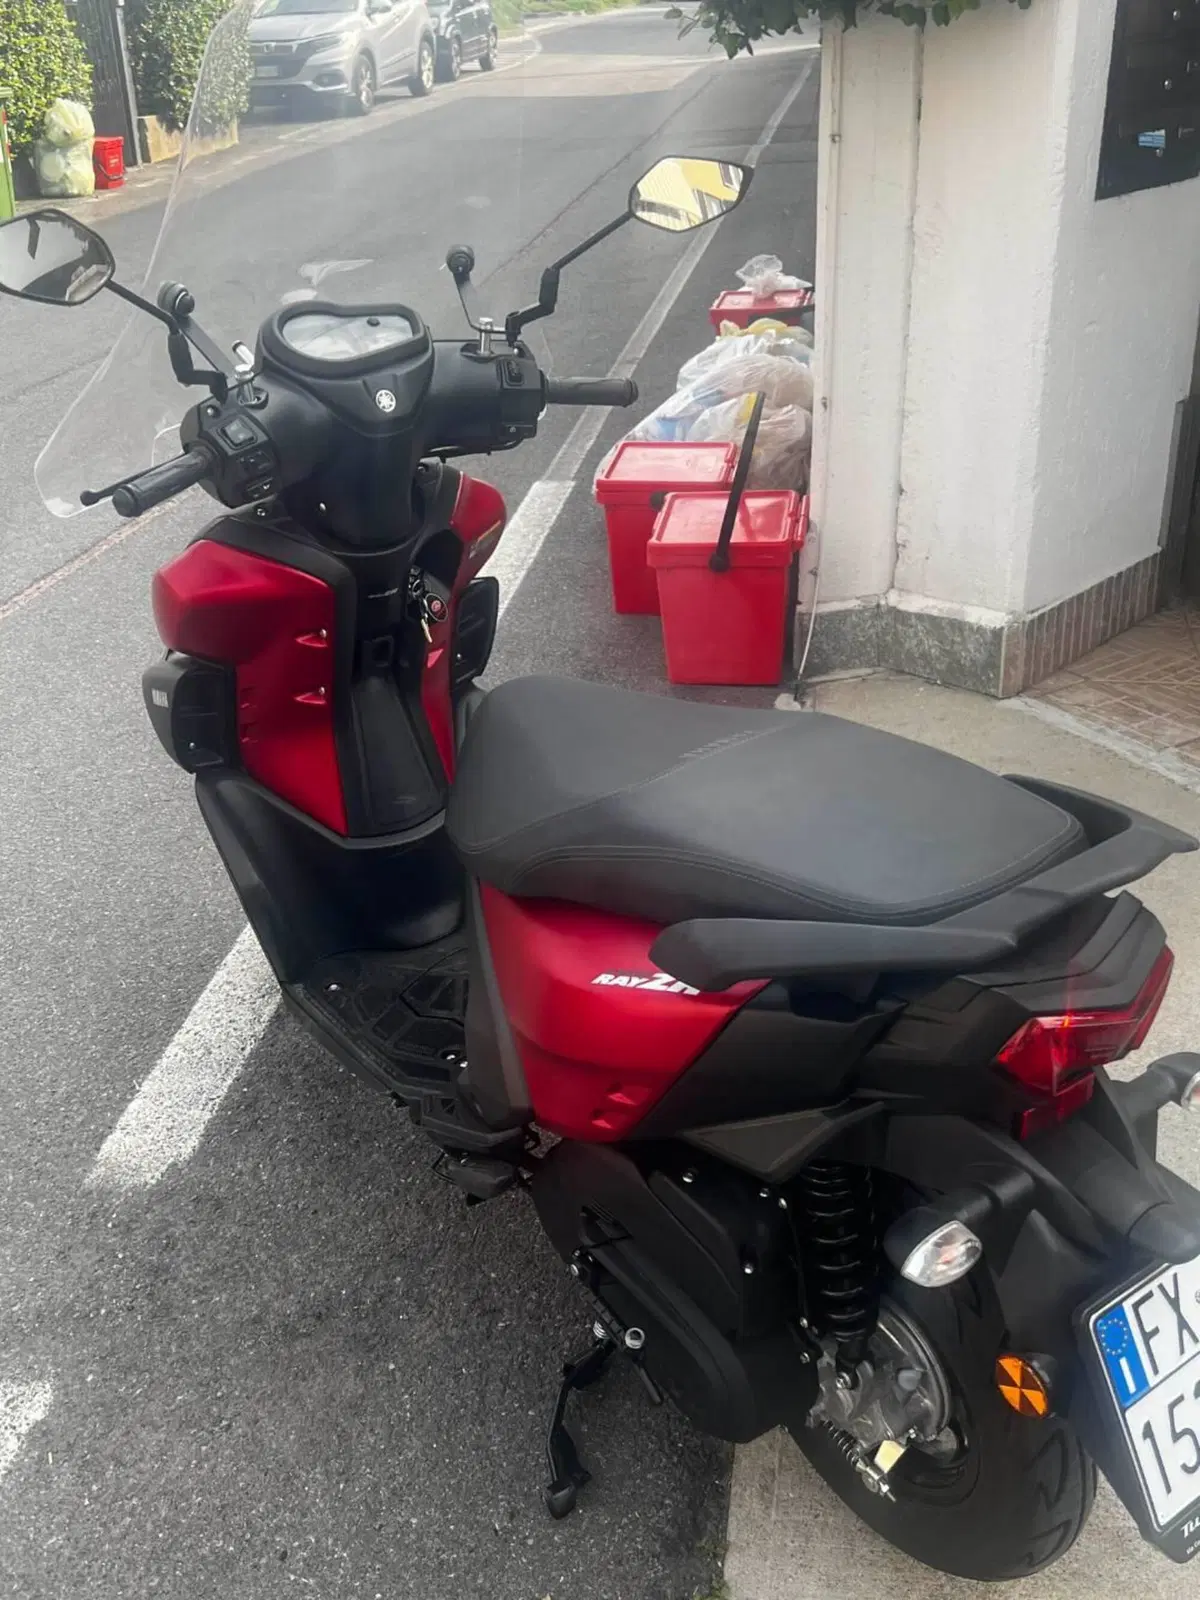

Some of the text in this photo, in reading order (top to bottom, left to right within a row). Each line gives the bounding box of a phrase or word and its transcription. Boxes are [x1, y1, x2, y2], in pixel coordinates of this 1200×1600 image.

[1119, 1356, 1137, 1395] I
[1132, 1272, 1200, 1376] FX
[1142, 1379, 1200, 1495] 15
